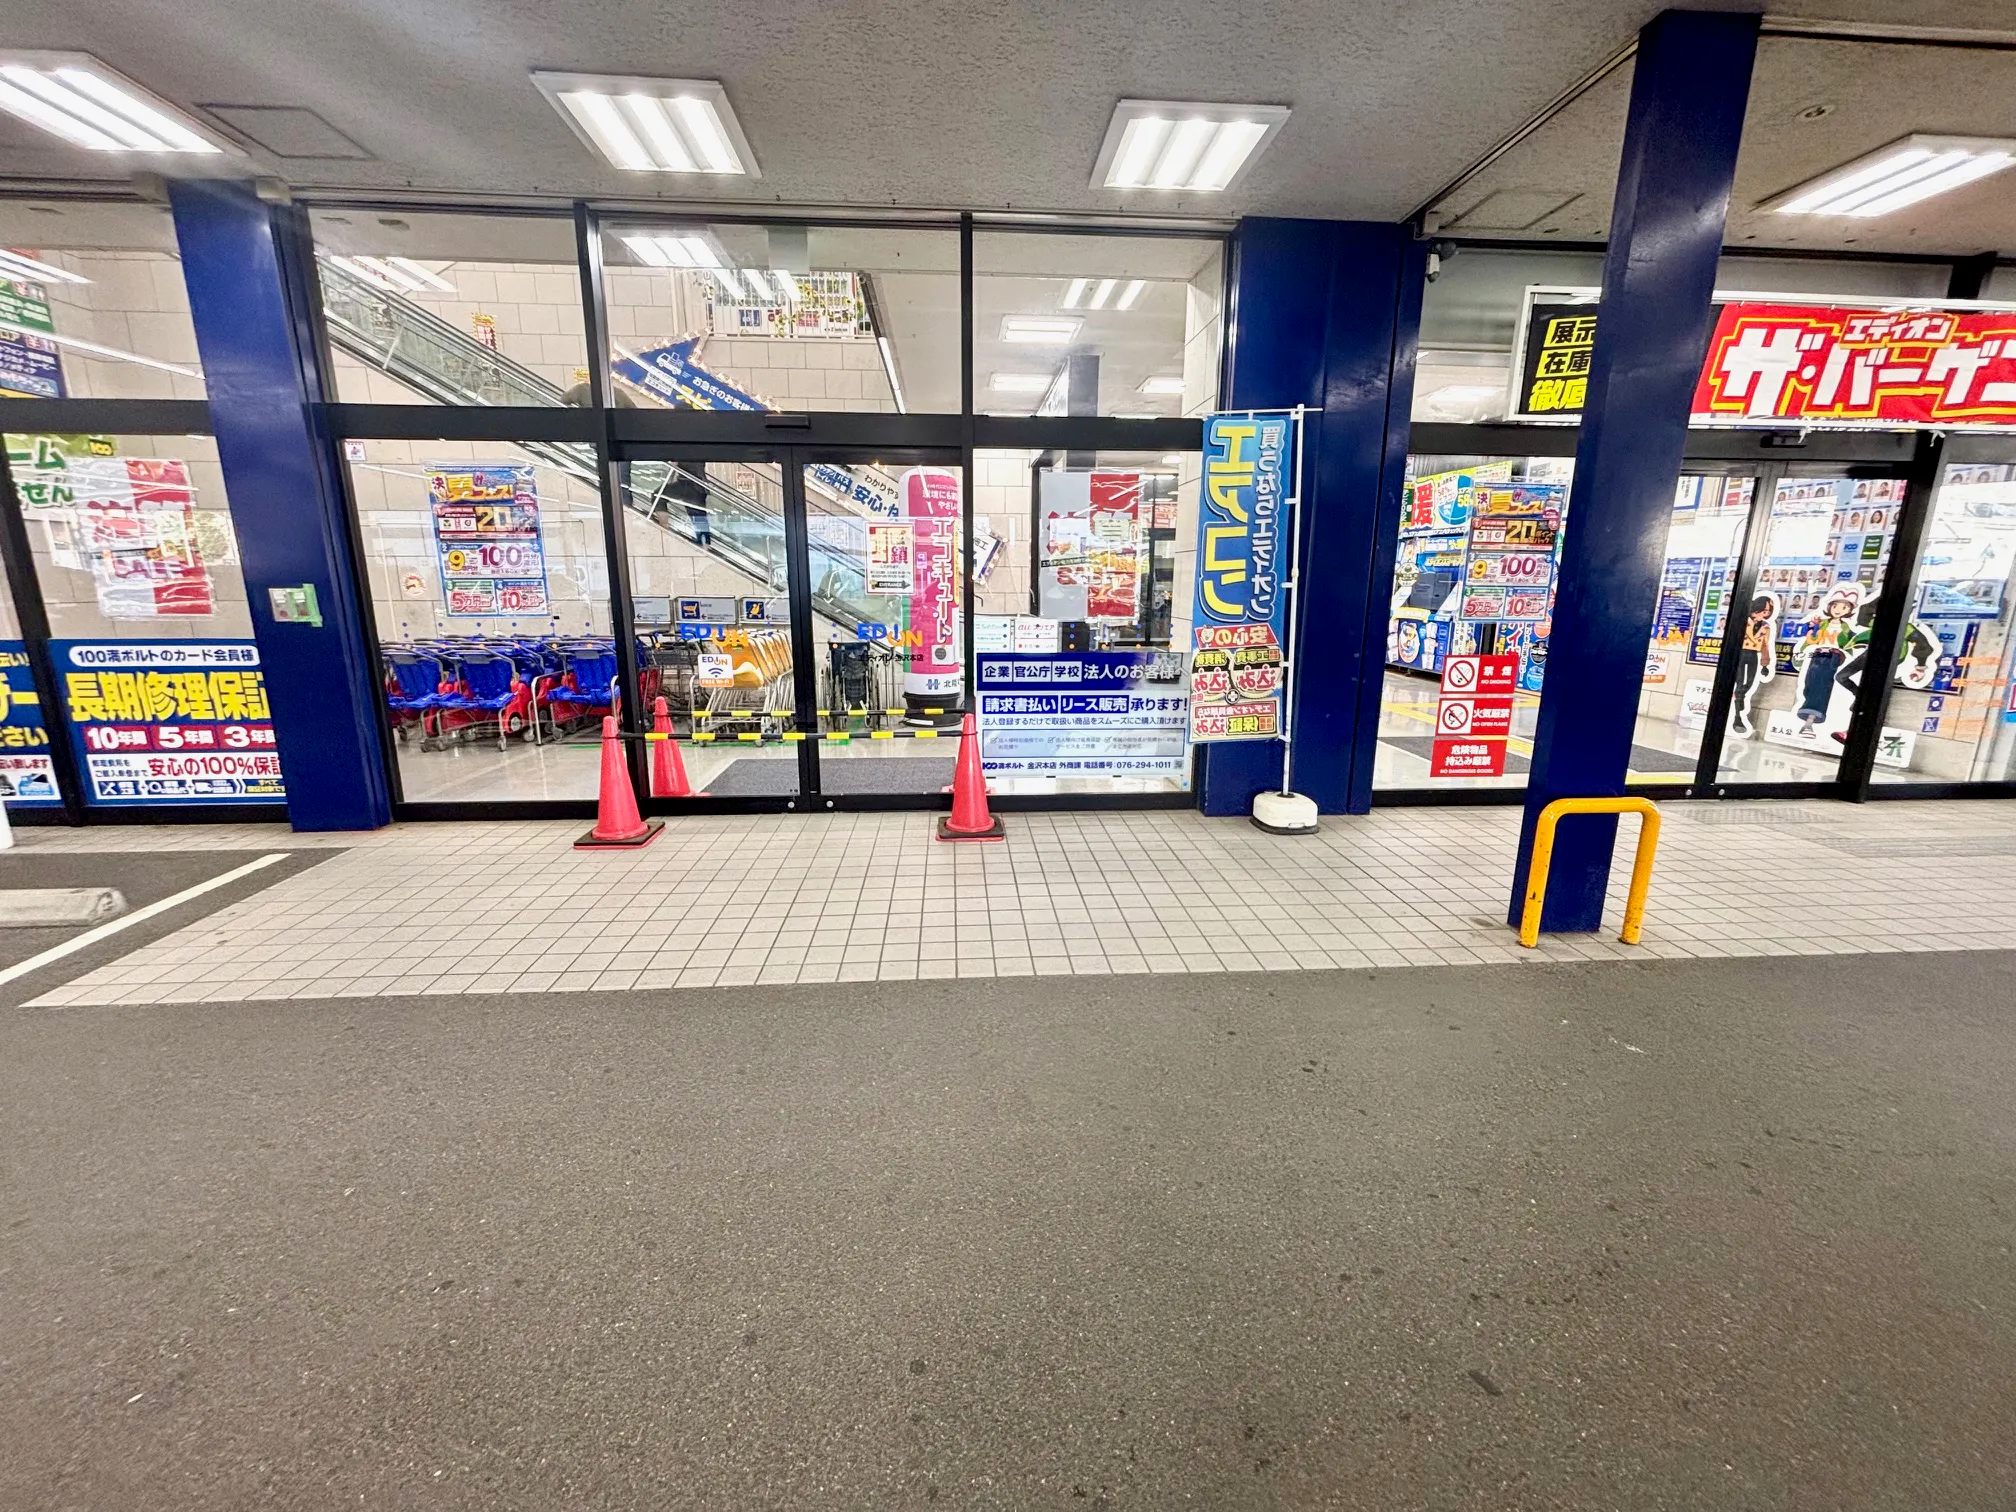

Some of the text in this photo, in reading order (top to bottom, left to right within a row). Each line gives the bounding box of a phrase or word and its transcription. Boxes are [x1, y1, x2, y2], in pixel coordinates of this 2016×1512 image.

[1846, 312, 1953, 344] エディオン
[1544, 352, 1592, 374] 在庫
[1504, 520, 1538, 543] 20
[479, 545, 522, 568] 100
[1500, 556, 1537, 577] 100
[857, 623, 923, 648] EDION
[77, 649, 255, 664] 100満ボルトのカード会員様
[702, 656, 728, 666] EDION
[984, 664, 1189, 680] 企業 官公庁 学校 法人のお客様へ
[985, 697, 1188, 713] 請求書払い リース販売 承ります!
[87, 726, 149, 750] 10年間
[158, 726, 215, 749] 5年間
[1771, 726, 1792, 735] 主人公
[1027, 762, 1057, 770] 金沢本店
[1059, 762, 1081, 770] 外商課
